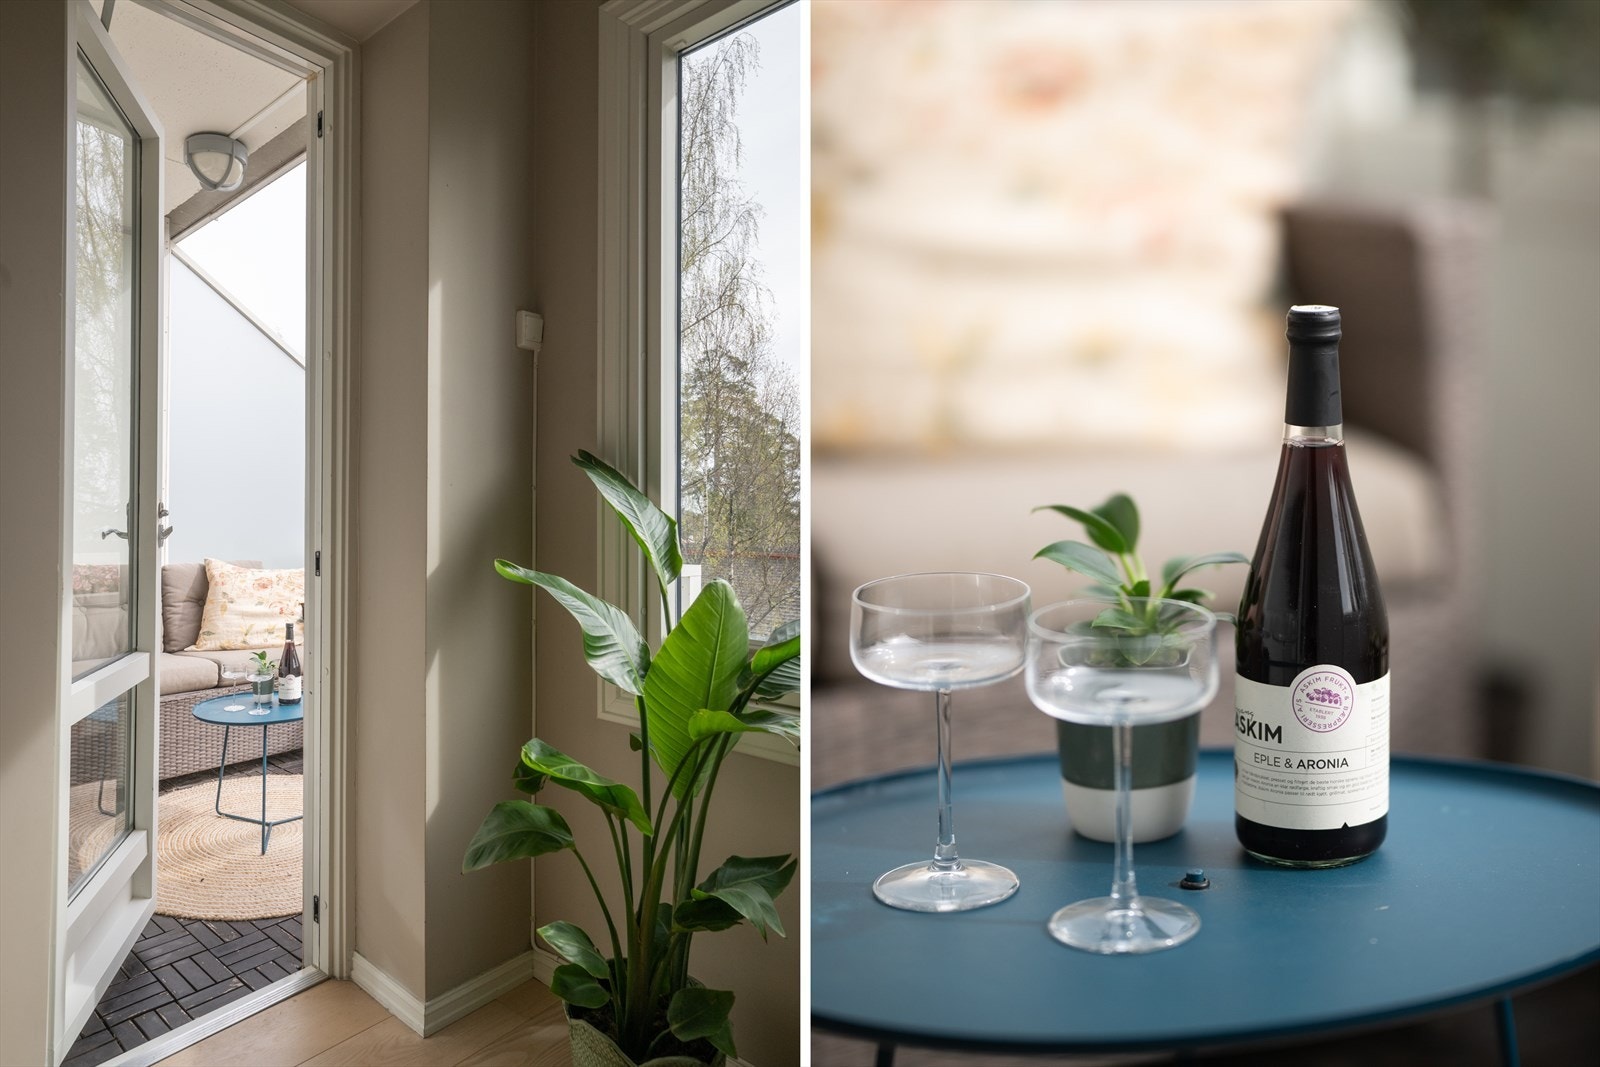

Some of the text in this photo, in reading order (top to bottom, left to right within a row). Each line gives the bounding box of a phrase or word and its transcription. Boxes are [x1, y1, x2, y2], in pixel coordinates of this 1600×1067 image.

[1300, 676, 1322, 694] ASKIM
[1254, 752, 1349, 770] EPLE & ARONIA
